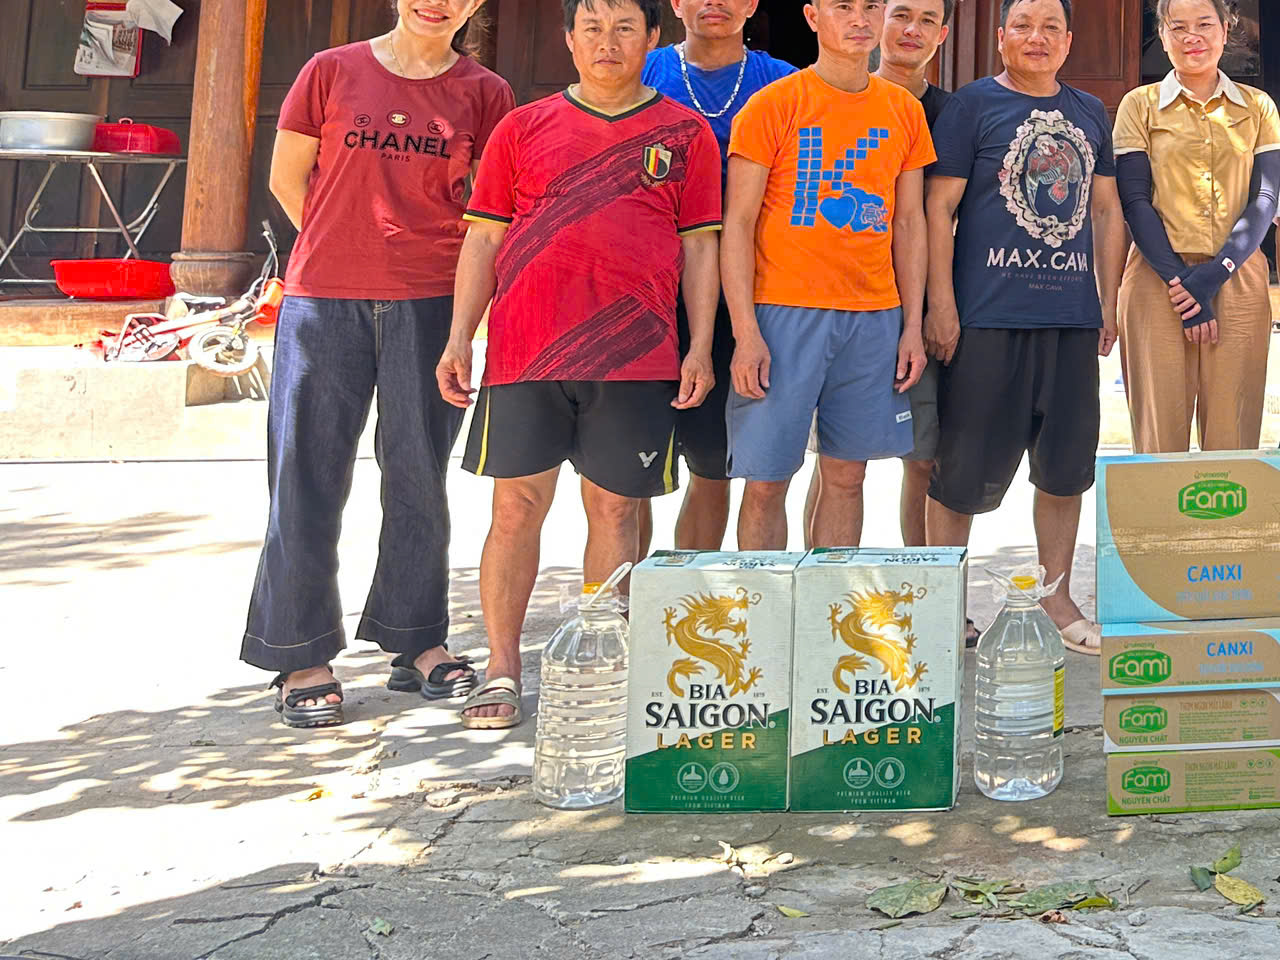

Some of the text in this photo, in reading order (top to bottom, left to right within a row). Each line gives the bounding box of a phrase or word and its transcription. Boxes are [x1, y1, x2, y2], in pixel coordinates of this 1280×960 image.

[344, 129, 451, 160] CHANEL
[381, 152, 411, 162] PARIS
[1187, 563, 1243, 583] CANXI
[1207, 641, 1254, 657] CANXI
[689, 684, 728, 700] BIA
[855, 679, 893, 696] BIA
[645, 701, 771, 728] SAIGON
[811, 698, 936, 725] SAIGON
[656, 732, 757, 750] LAGER
[823, 727, 923, 745] LAGER
